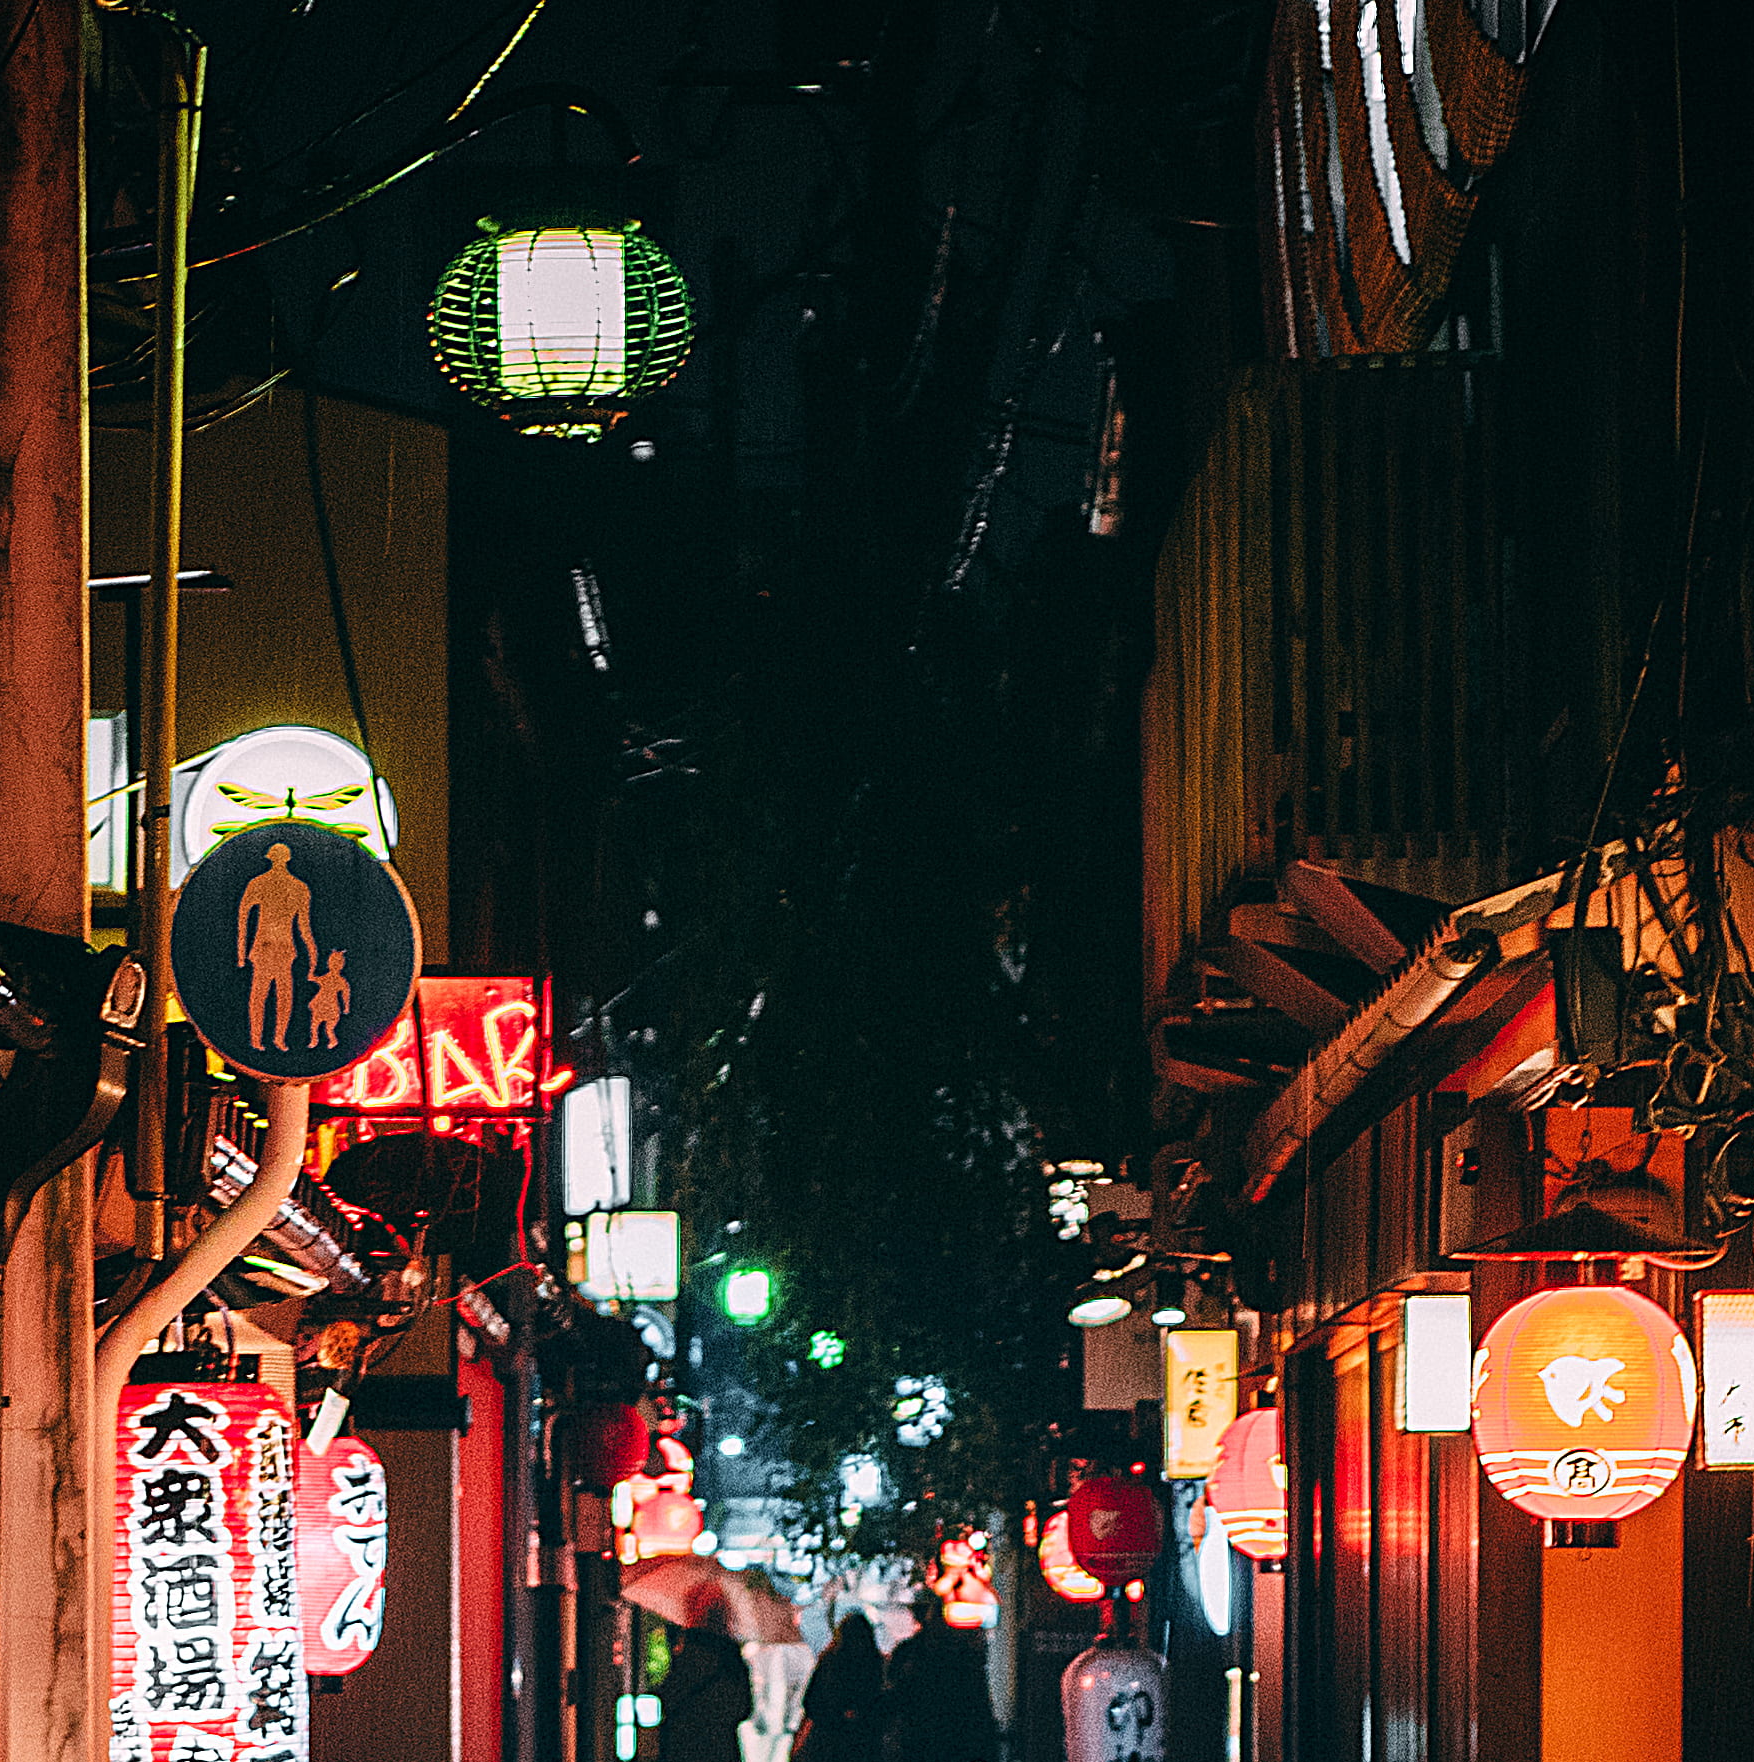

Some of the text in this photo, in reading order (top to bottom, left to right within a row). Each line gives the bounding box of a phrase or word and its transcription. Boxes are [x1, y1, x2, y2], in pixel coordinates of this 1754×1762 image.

[355, 1002, 536, 1107] BAR
[139, 1392, 226, 1711] 大衆酒場
